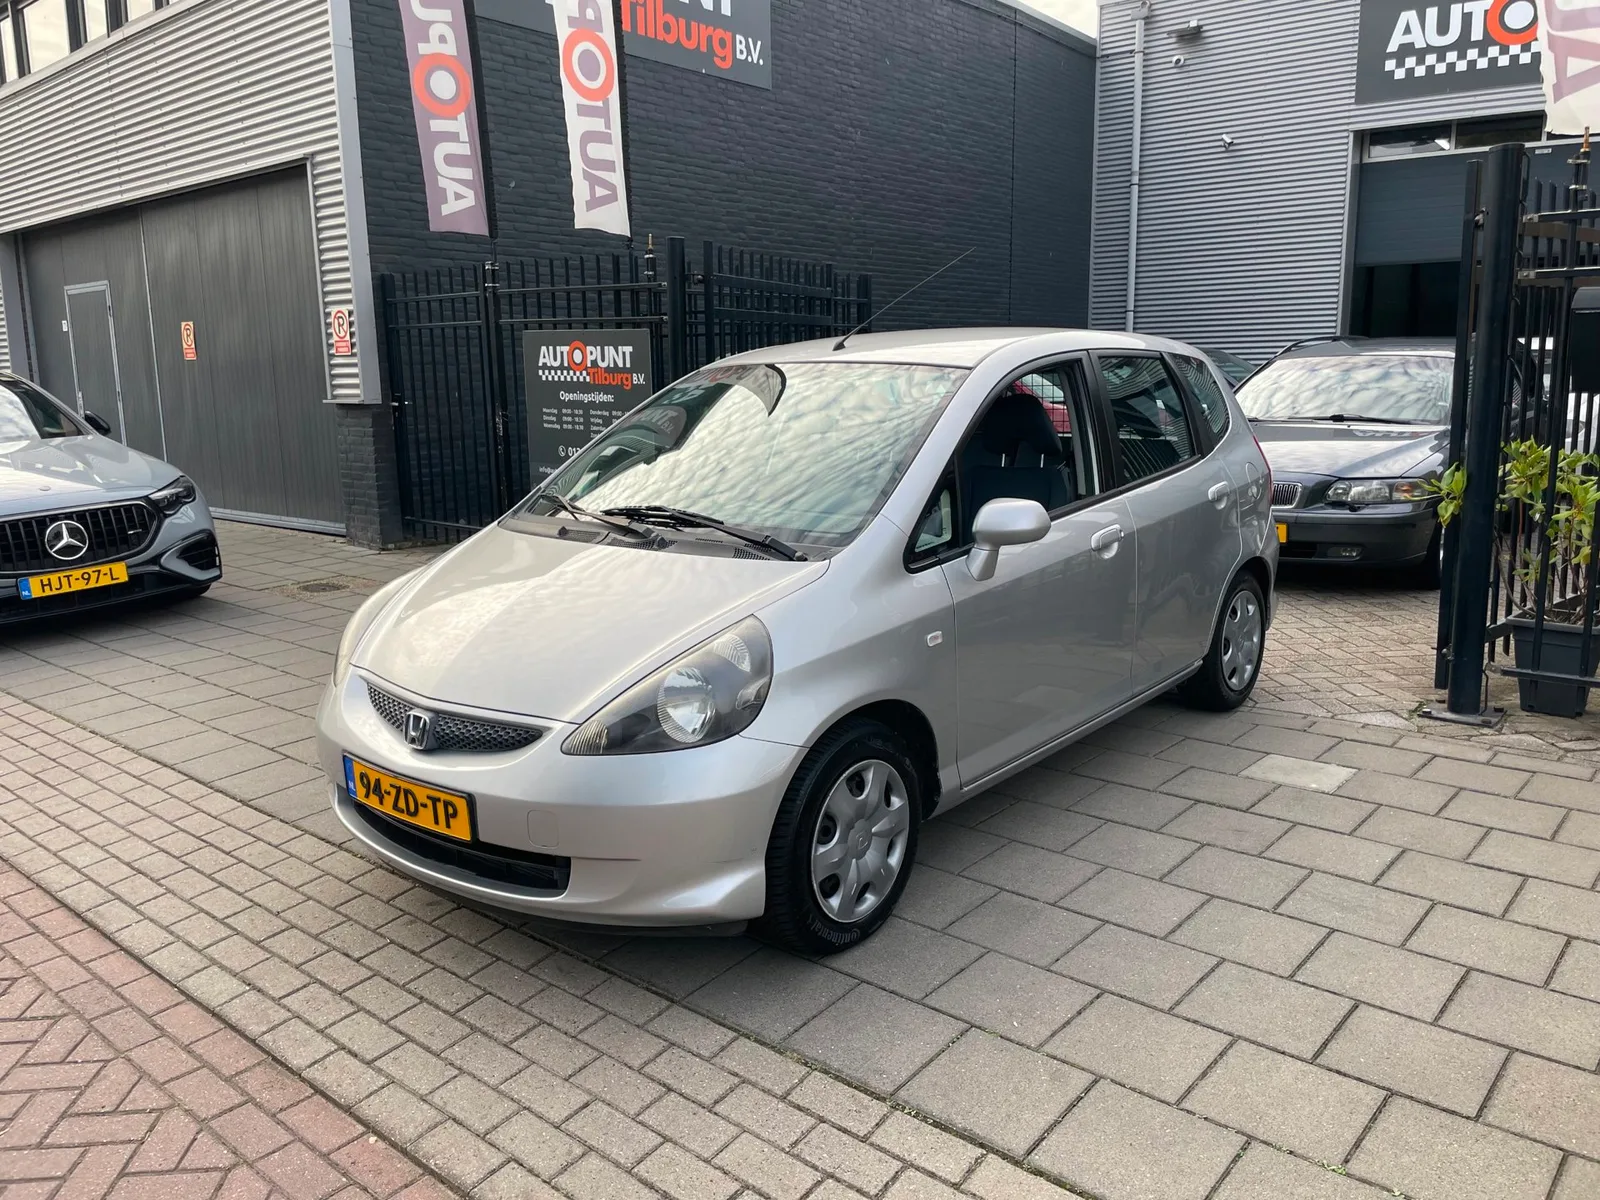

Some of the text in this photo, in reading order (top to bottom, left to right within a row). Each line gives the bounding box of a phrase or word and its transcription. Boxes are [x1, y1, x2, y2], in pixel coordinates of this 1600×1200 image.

[736, 34, 764, 66] B.V.
[538, 340, 633, 371] AUTOPUNT
[587, 367, 632, 390] Tilburg
[559, 390, 615, 404] Openingstijden:
[40, 567, 120, 593] HJT-97-L
[359, 770, 458, 829] 94-ZD-TP
